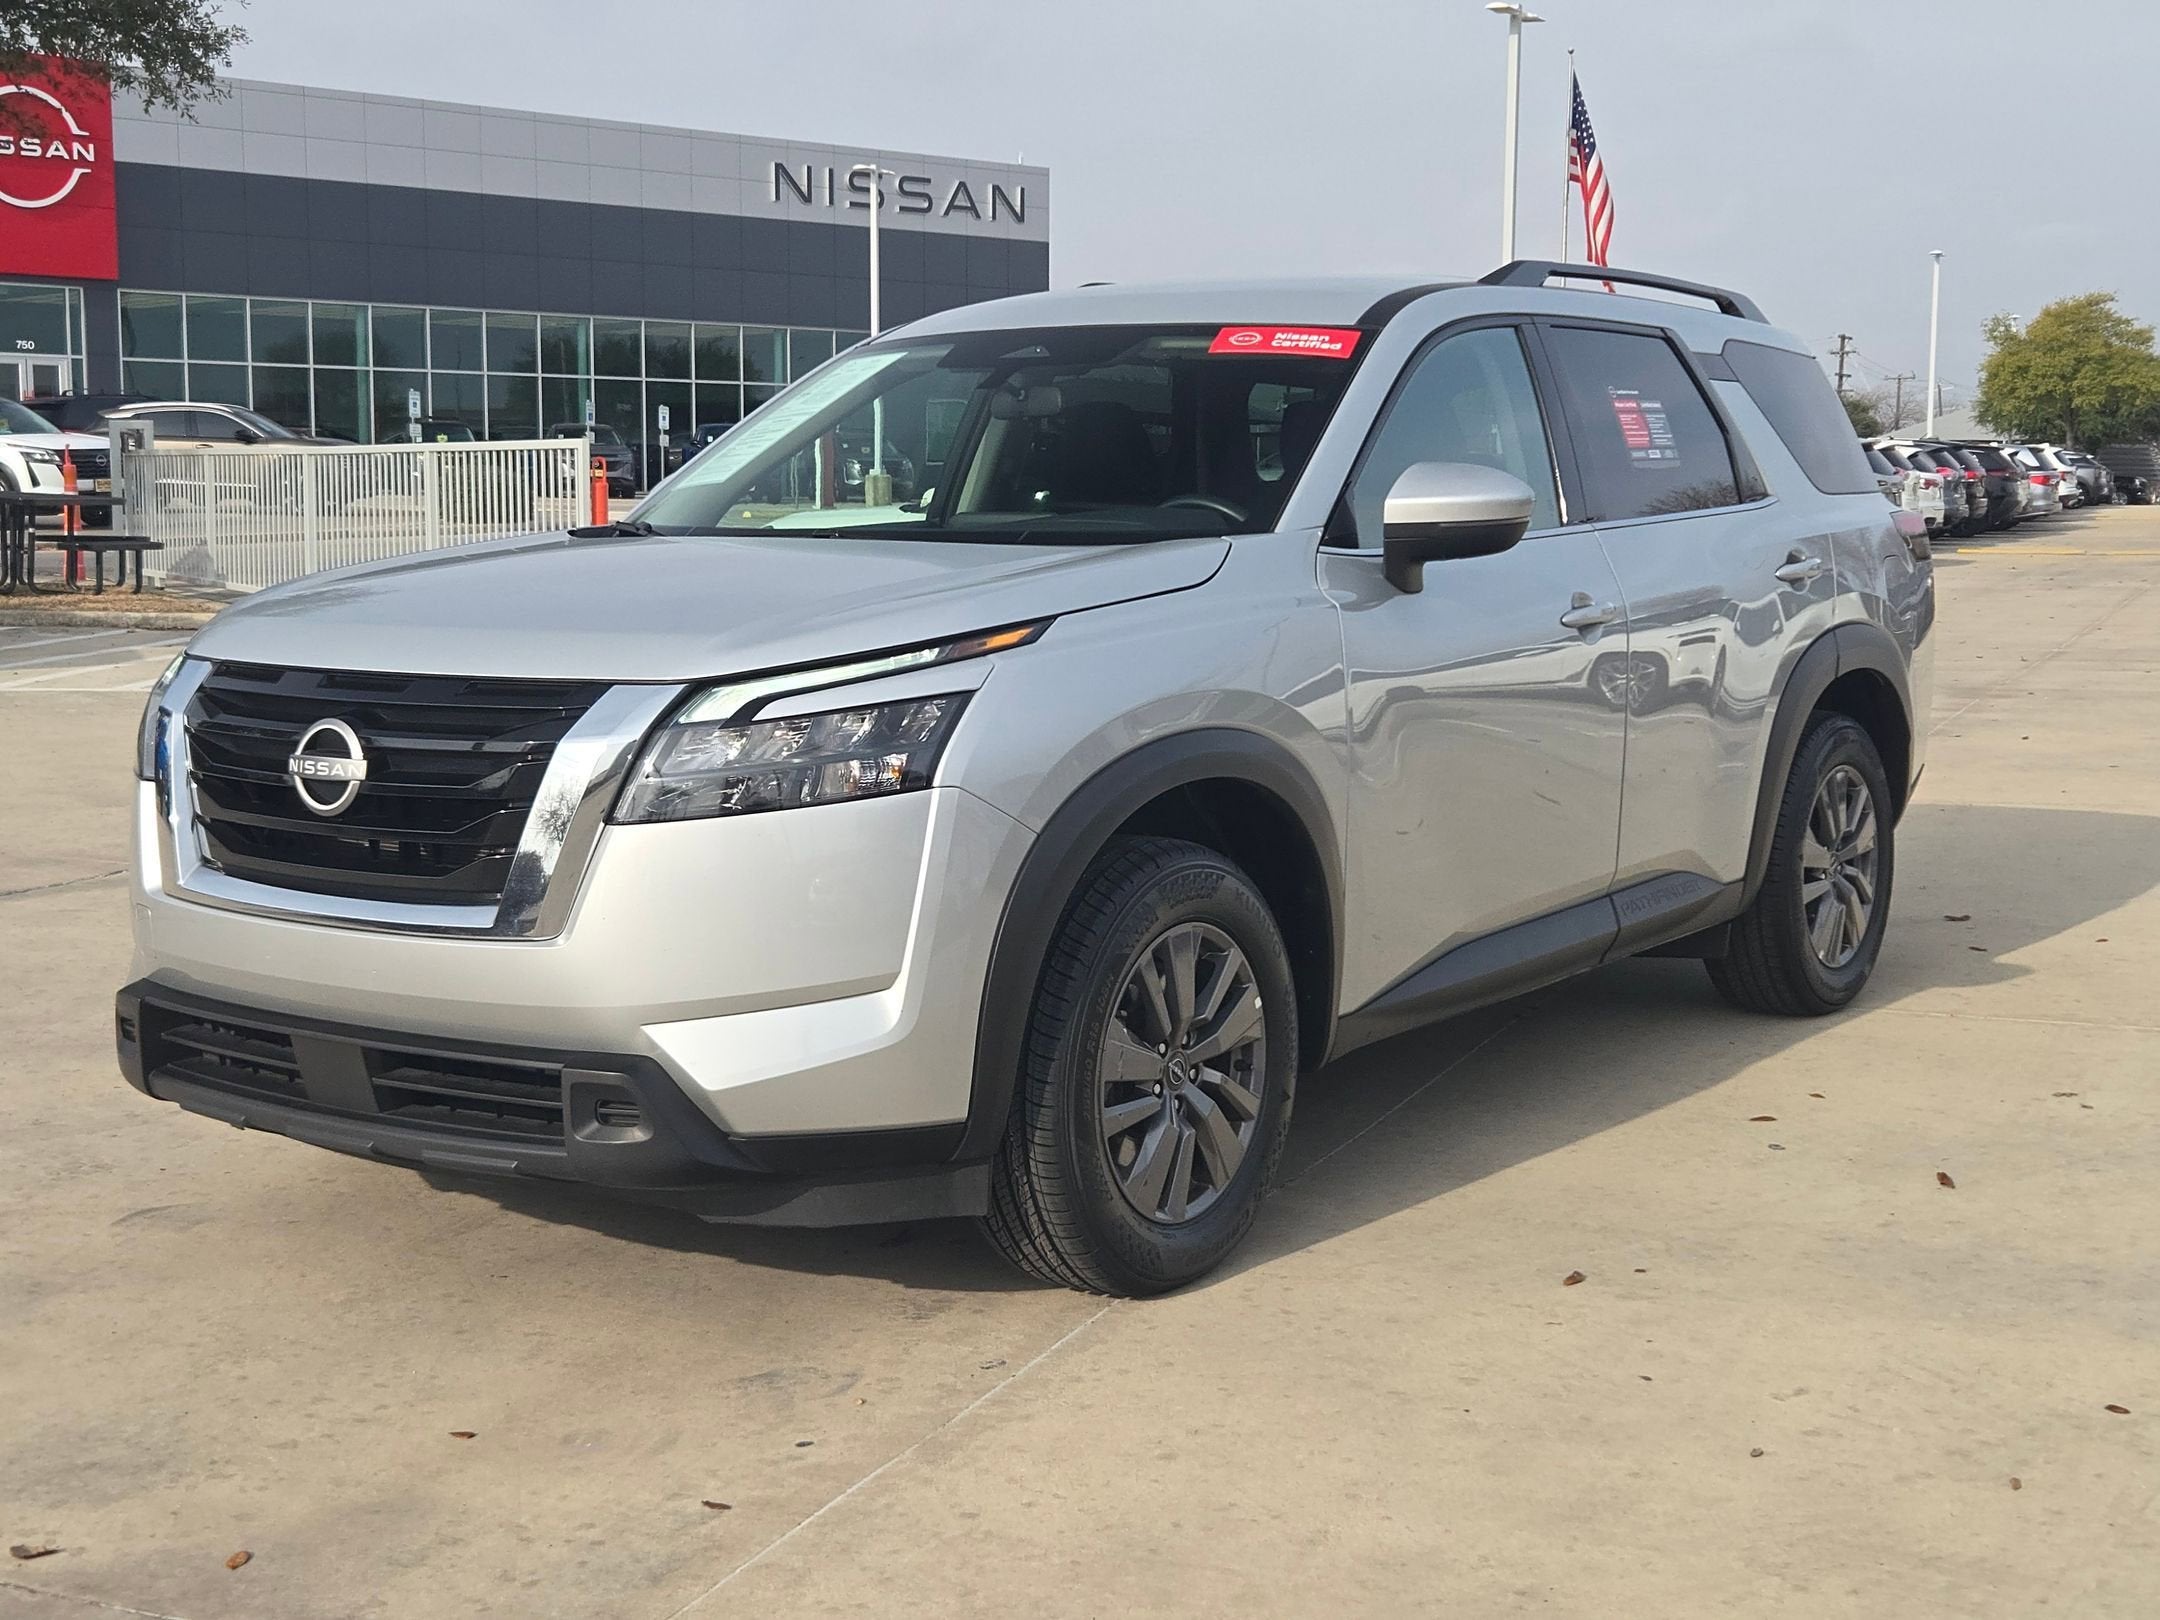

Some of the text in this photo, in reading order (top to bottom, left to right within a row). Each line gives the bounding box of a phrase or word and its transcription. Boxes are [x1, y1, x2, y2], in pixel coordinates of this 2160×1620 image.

[772, 161, 1025, 224] NISSAN
[1274, 332, 1330, 341] Nissan
[15, 340, 35, 350] 750
[1271, 340, 1342, 350] Certified
[289, 758, 364, 777] NISSAN
